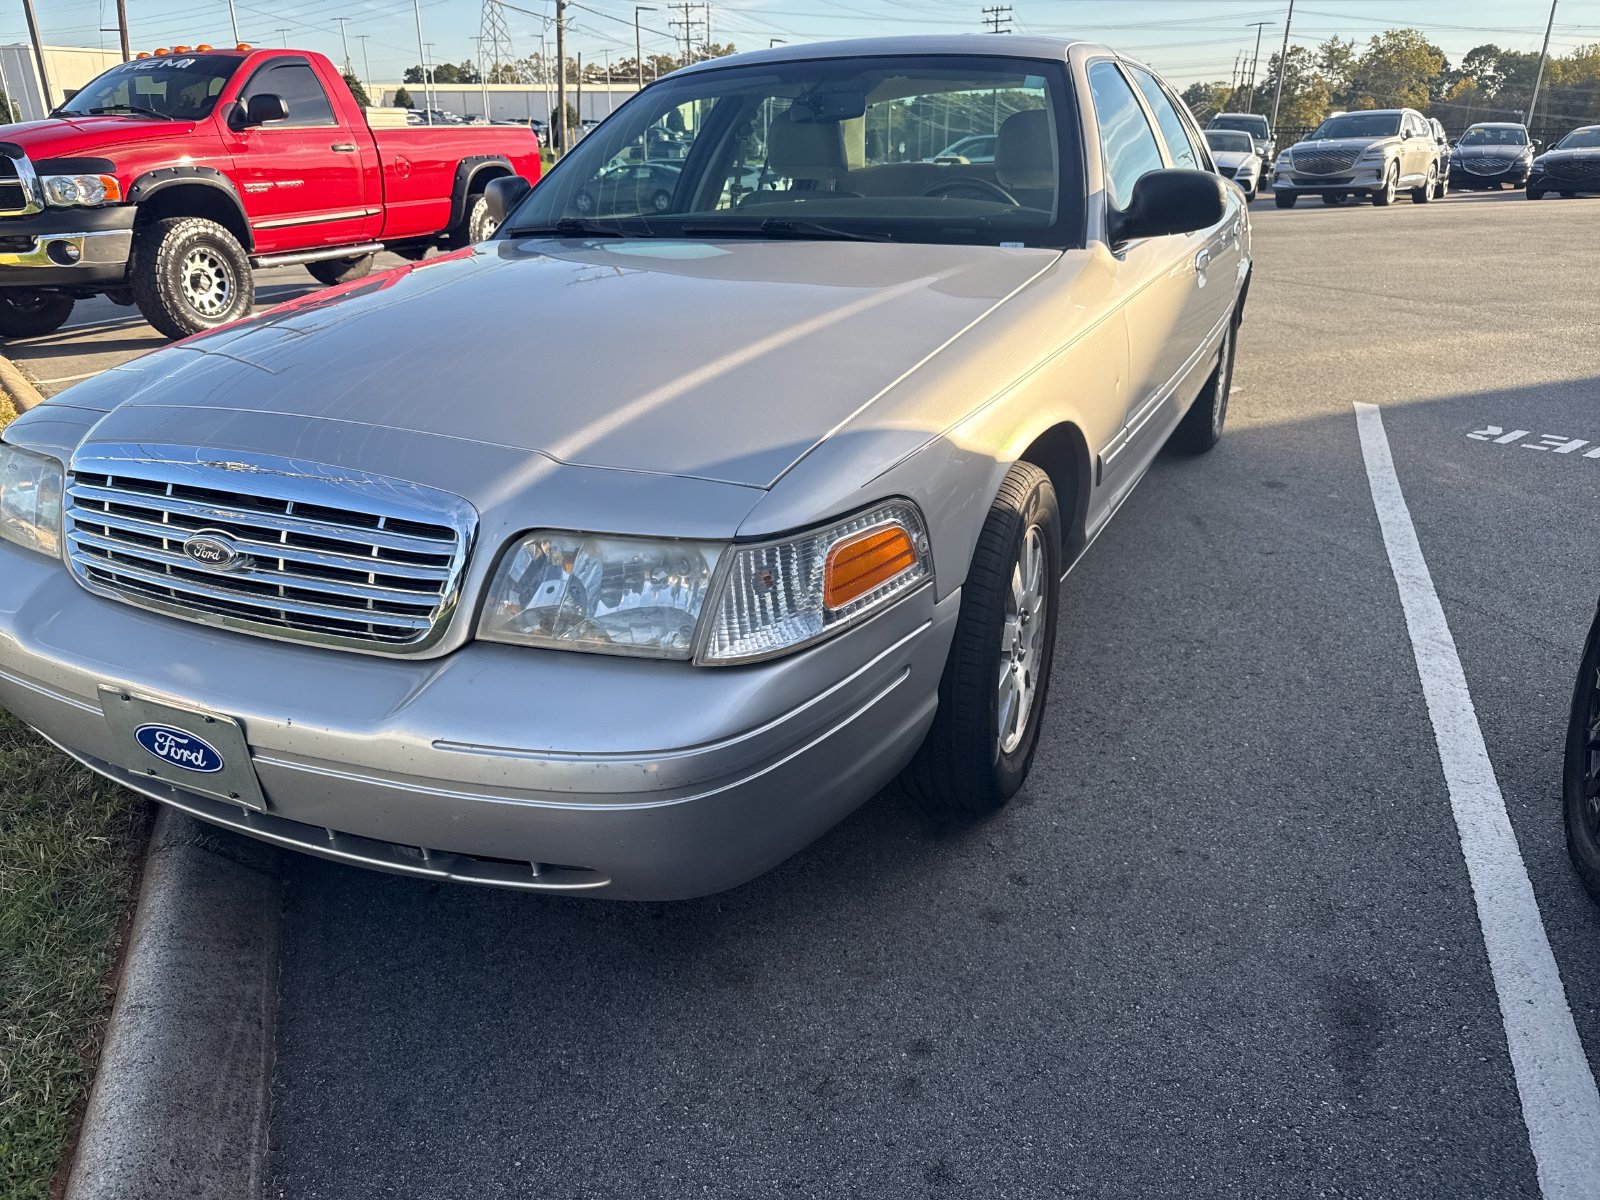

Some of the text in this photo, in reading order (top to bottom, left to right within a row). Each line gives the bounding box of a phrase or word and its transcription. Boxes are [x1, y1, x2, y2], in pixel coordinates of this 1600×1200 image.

[120, 58, 196, 72] HEMI
[193, 542, 221, 561] Ford
[153, 730, 207, 767] Ford
